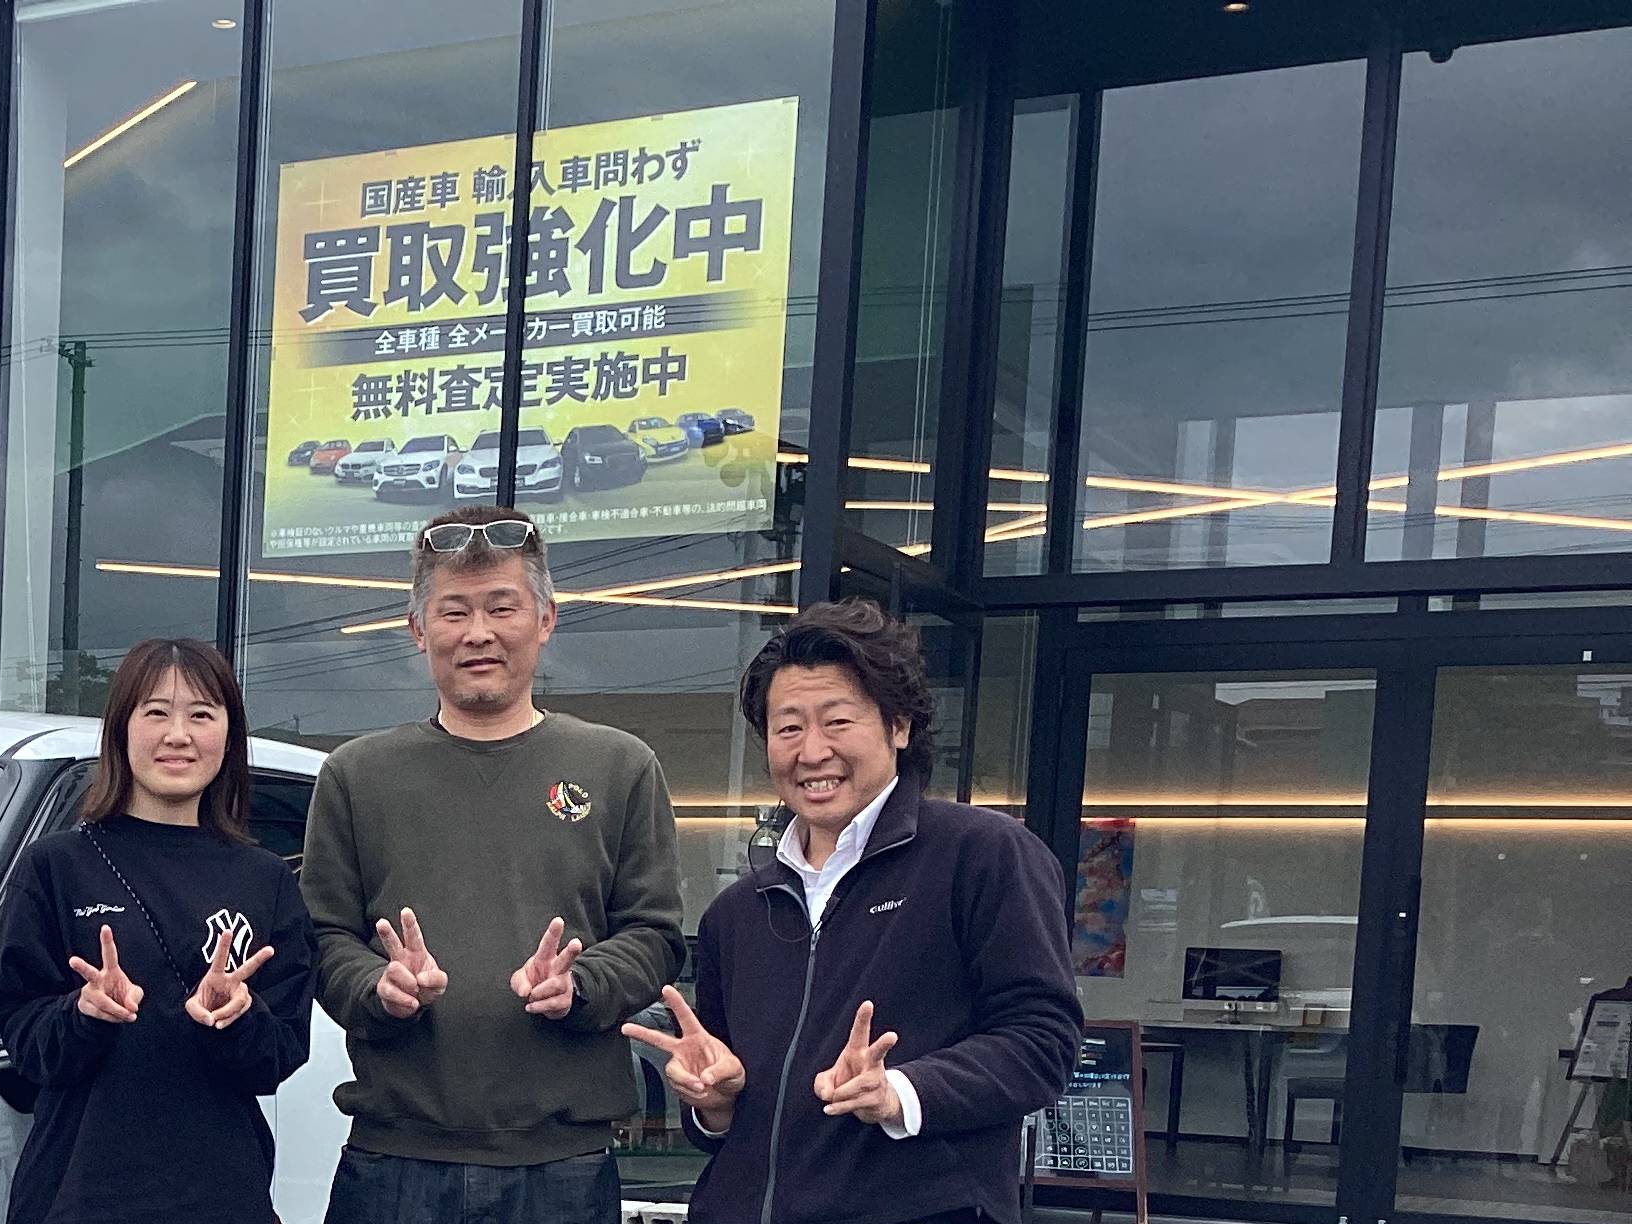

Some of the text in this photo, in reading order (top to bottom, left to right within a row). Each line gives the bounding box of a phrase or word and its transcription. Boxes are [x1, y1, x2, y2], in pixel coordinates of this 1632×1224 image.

[361, 138, 703, 218] 国産車 輸入車問わず
[298, 183, 764, 324] 買取強化中
[375, 305, 666, 356] 全車種 全メーカー買取可能
[350, 346, 688, 421] 無料査定実施中
